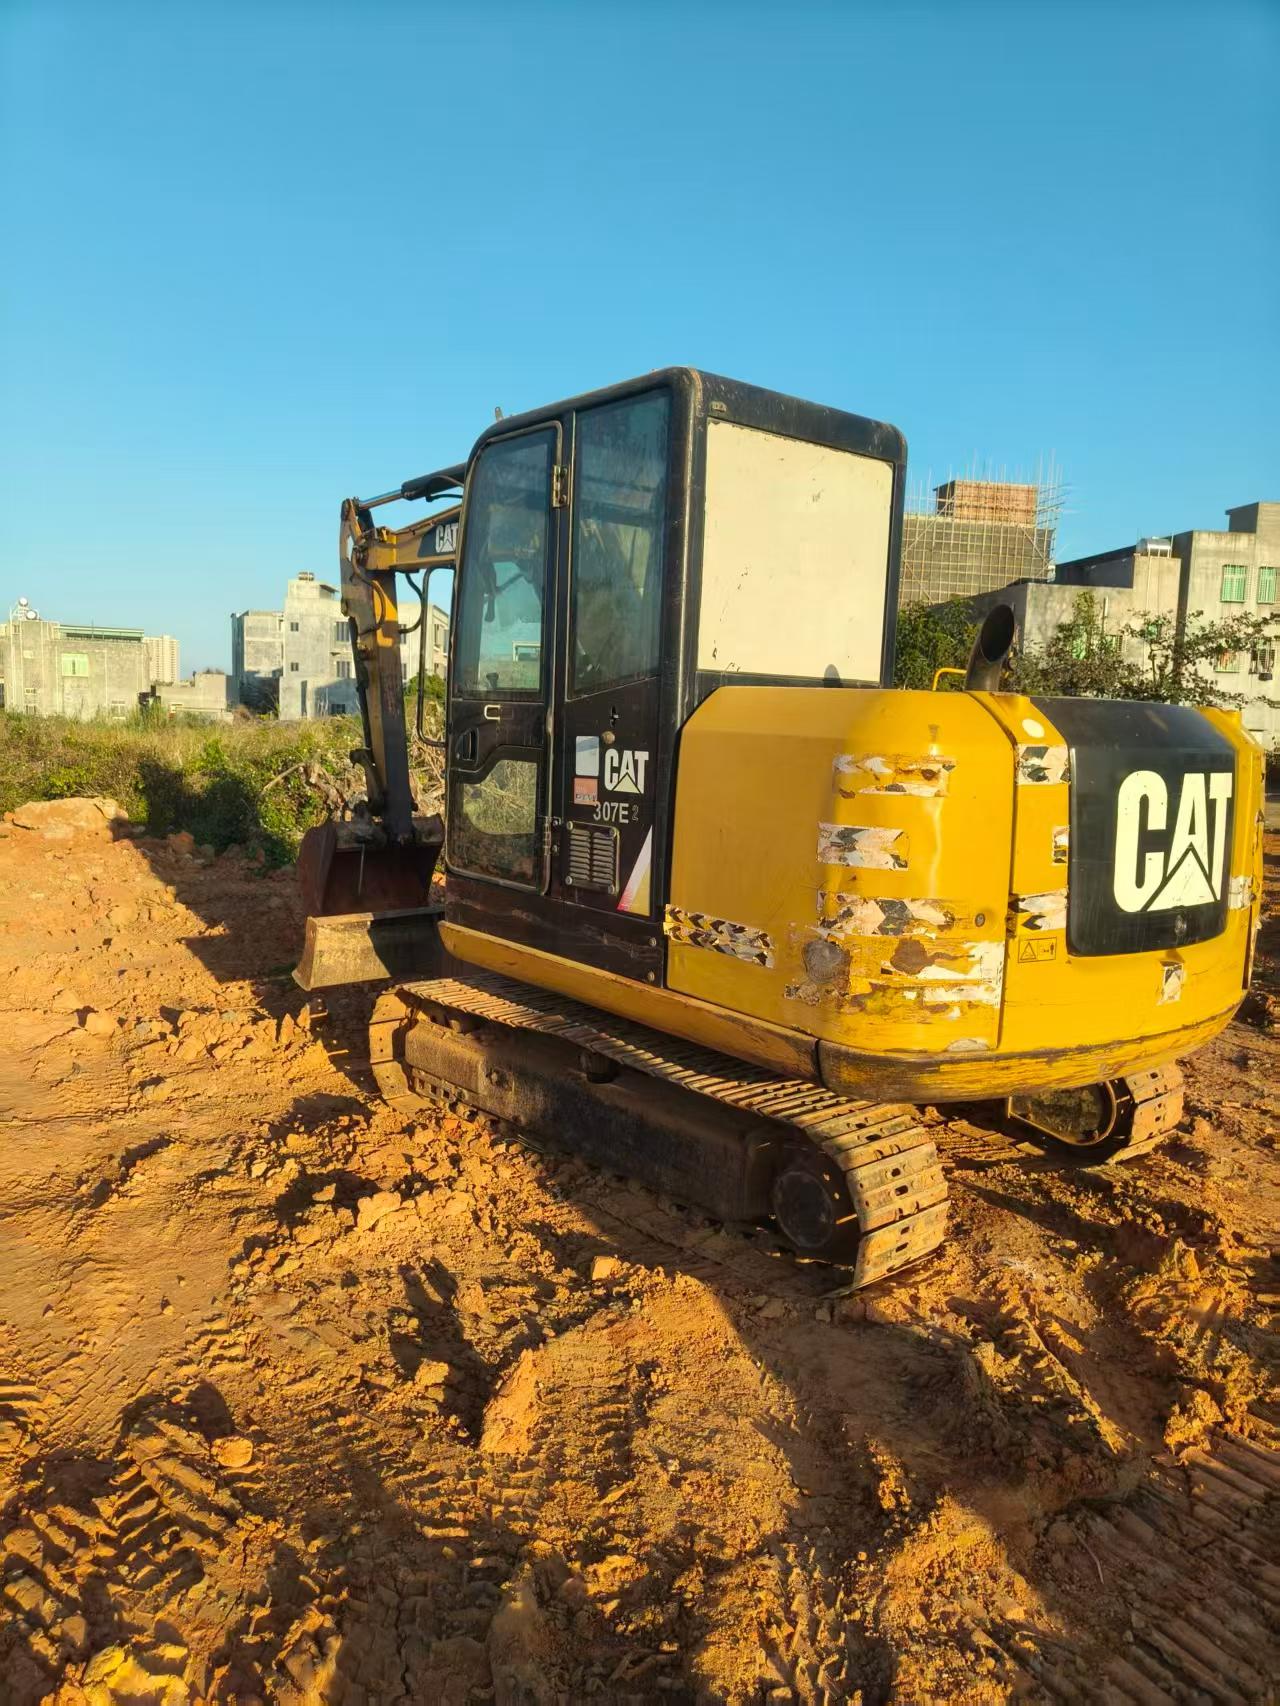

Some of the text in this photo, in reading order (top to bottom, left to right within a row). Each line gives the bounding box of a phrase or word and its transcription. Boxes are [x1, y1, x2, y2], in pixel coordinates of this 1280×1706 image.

[435, 522, 459, 553] CAT
[604, 748, 649, 794] CAT
[1113, 770, 1233, 913] CAT
